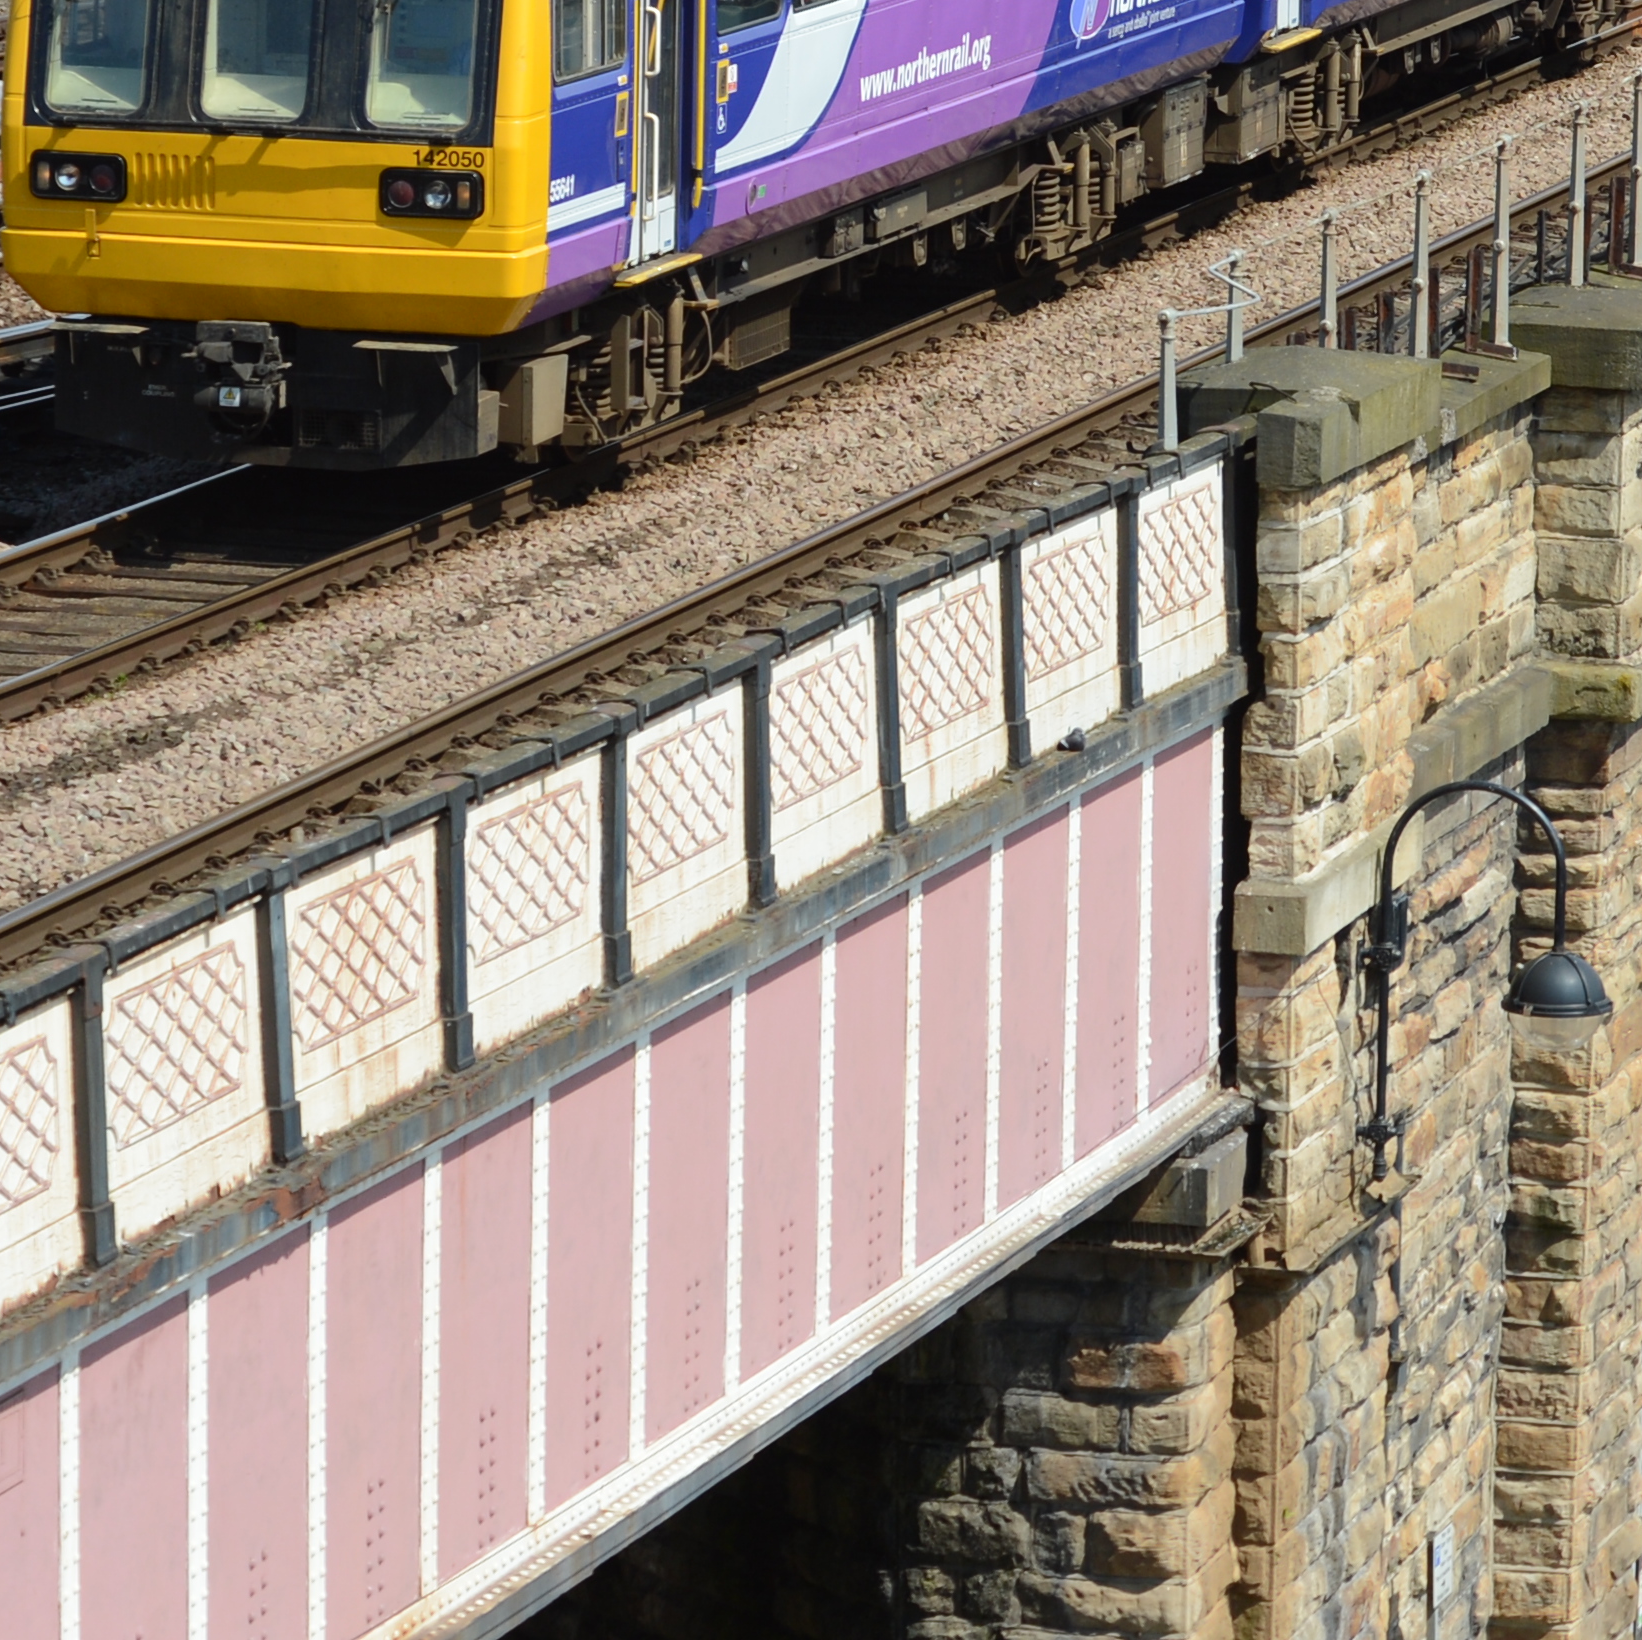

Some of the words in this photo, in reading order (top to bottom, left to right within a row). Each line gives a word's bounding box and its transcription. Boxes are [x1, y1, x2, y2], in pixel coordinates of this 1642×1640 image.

[860, 31, 992, 102] www.northernrail.org
[412, 148, 485, 168] 142050
[549, 173, 576, 203] 55641
